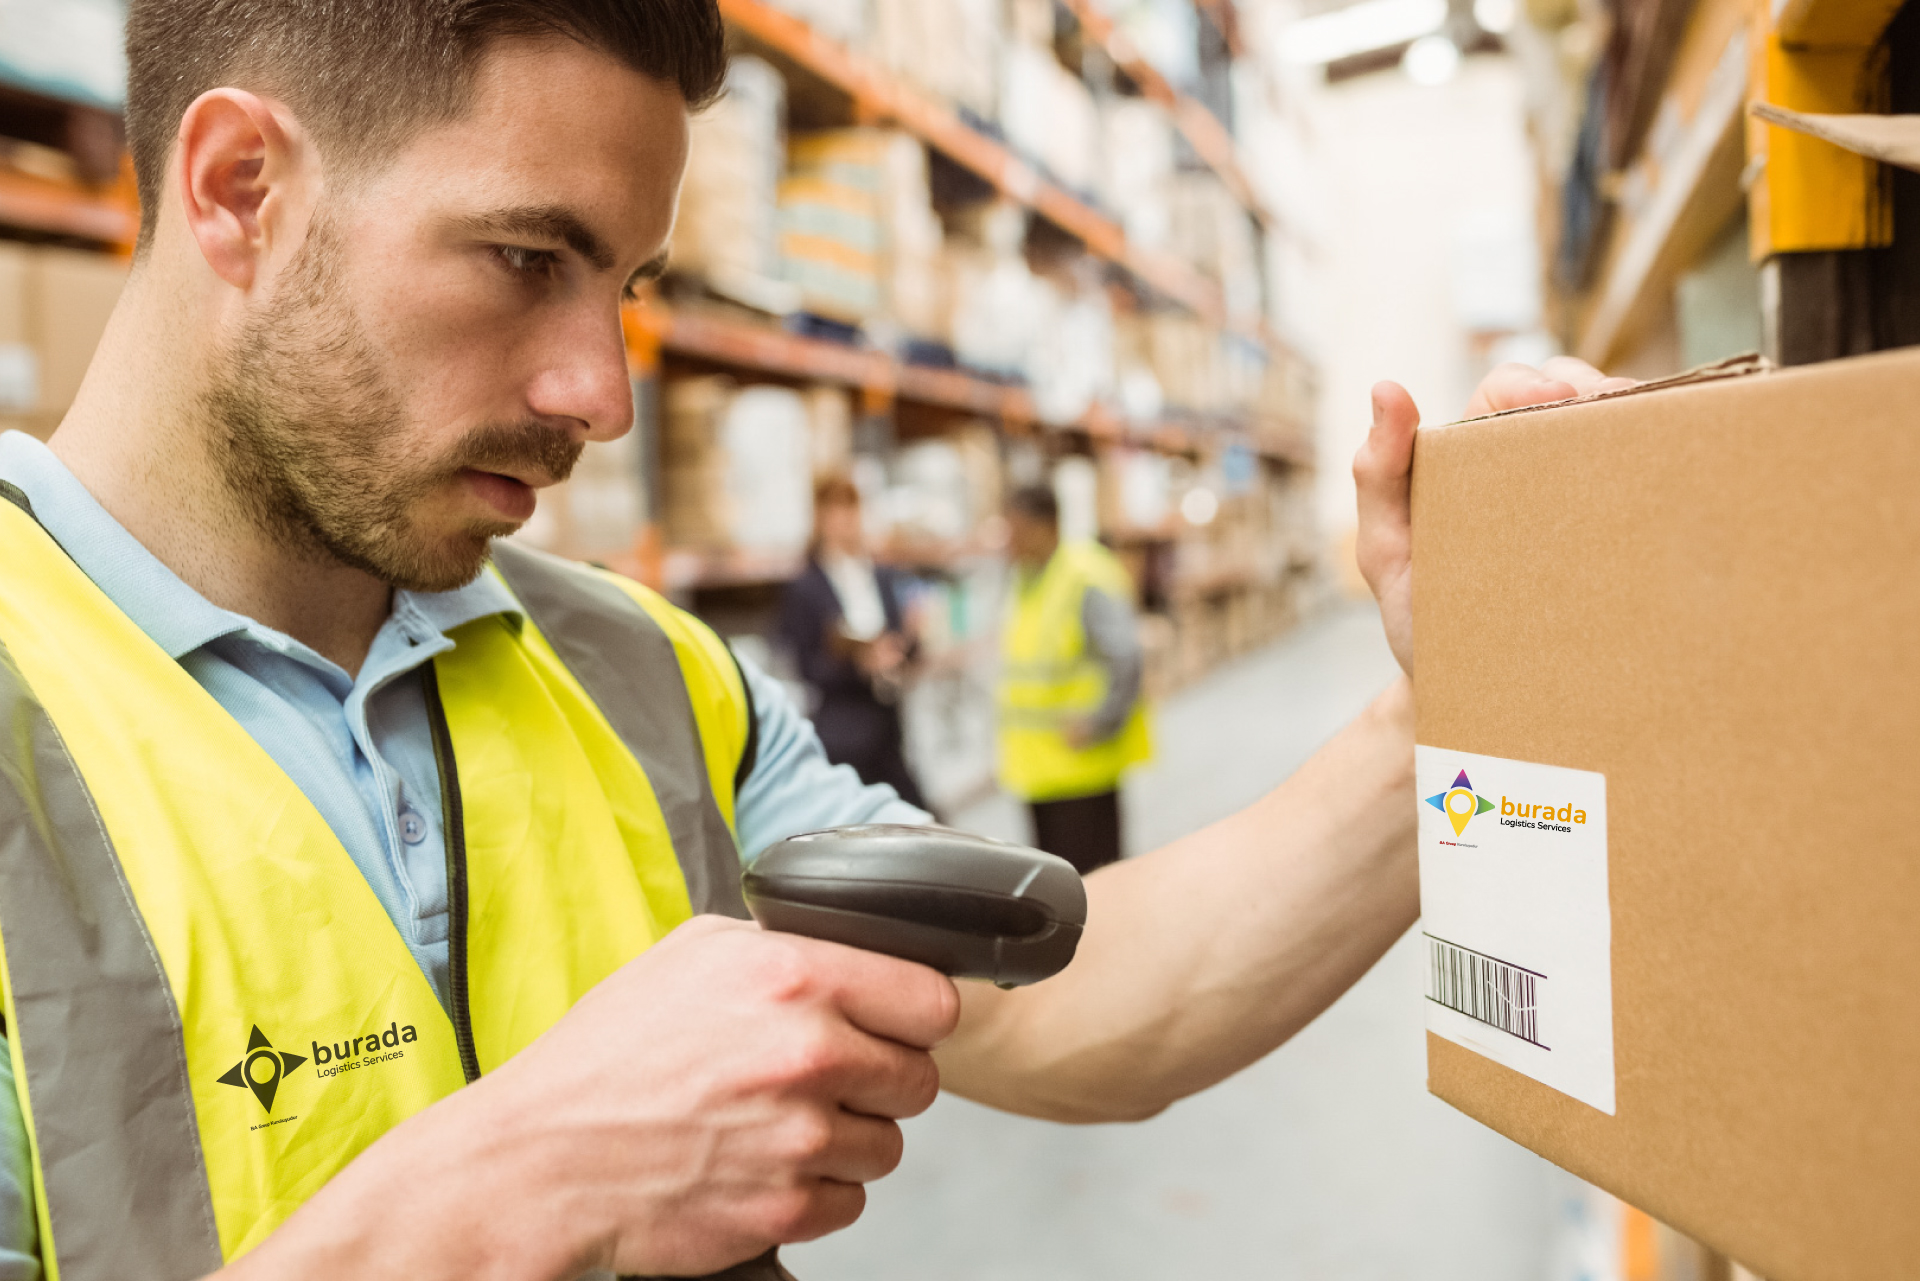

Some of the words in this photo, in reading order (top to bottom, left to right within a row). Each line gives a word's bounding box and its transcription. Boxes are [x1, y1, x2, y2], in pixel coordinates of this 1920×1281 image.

[1501, 796, 1586, 824] burada
[1500, 817, 1536, 829] Logistics
[1537, 821, 1571, 833] Services
[312, 1022, 417, 1065] burada
[317, 1061, 361, 1078] Logistics
[363, 1050, 404, 1066] Services
